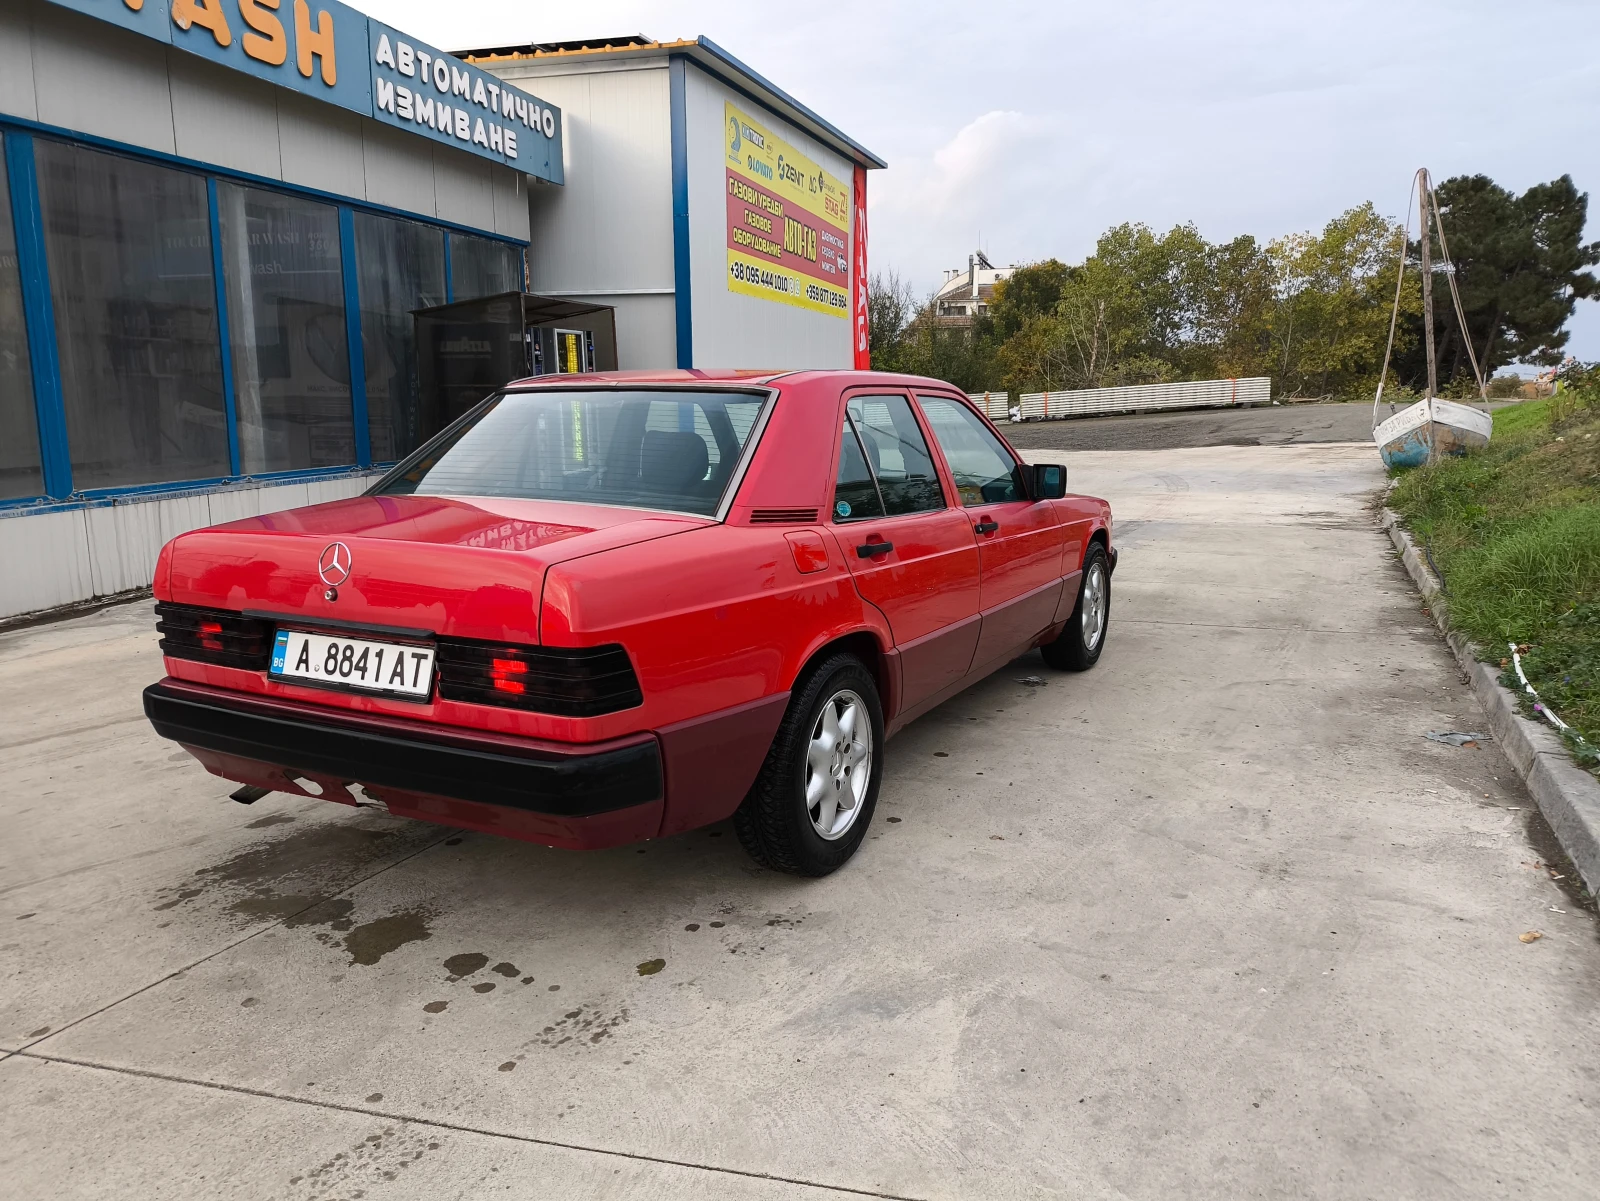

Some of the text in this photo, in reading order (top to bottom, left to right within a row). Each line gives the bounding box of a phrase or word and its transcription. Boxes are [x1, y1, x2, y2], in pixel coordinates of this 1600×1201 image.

[123, 0, 337, 87] ASH
[376, 33, 555, 140] АВТОМАТИЧНО
[376, 78, 519, 160] ИЗМИВАНЕ
[752, 158, 773, 181] LOVATO
[786, 163, 805, 188] ZENIT
[729, 177, 784, 219] ГАЗОВИ УРЕДБИ
[824, 196, 838, 216] STAG
[744, 209, 772, 234] ГАЗОВОЕ
[263, 231, 300, 246] WASH
[732, 229, 782, 259] ОБОРУДОВАНИЕ
[783, 215, 817, 263] АВТО-ГАЗ
[730, 262, 788, 293] +38 095 444 1010
[805, 284, 819, 302] +359
[820, 288, 829, 304] 877
[273, 657, 284, 668] BG
[295, 638, 428, 688] A 8841 AT
